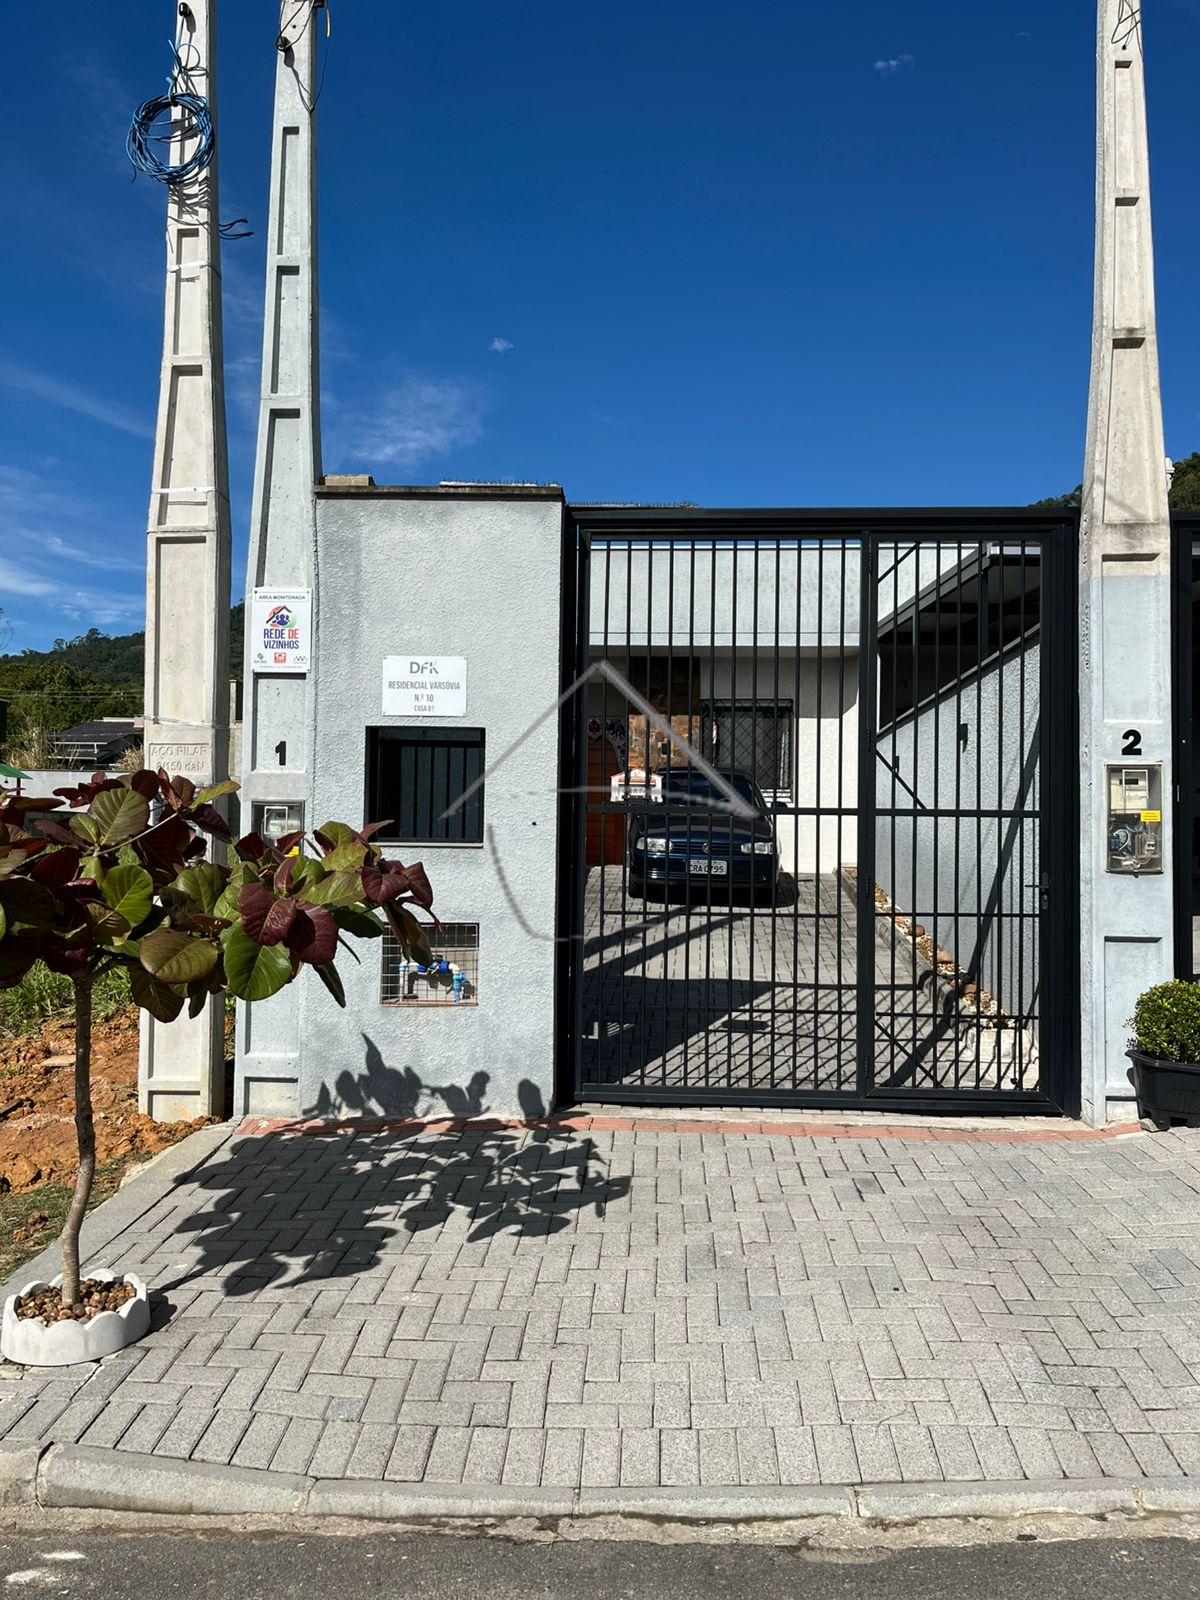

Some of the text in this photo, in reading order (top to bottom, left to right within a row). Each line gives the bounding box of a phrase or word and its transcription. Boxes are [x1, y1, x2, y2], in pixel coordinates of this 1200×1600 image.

[264, 629, 299, 639] REDE DE
[264, 640, 299, 649] VIZINHOS
[410, 661, 439, 674] DFK
[388, 681, 428, 689] RESIDENCIAL
[426, 694, 434, 702] 10
[1121, 729, 1142, 756] 2
[275, 740, 287, 766] 1
